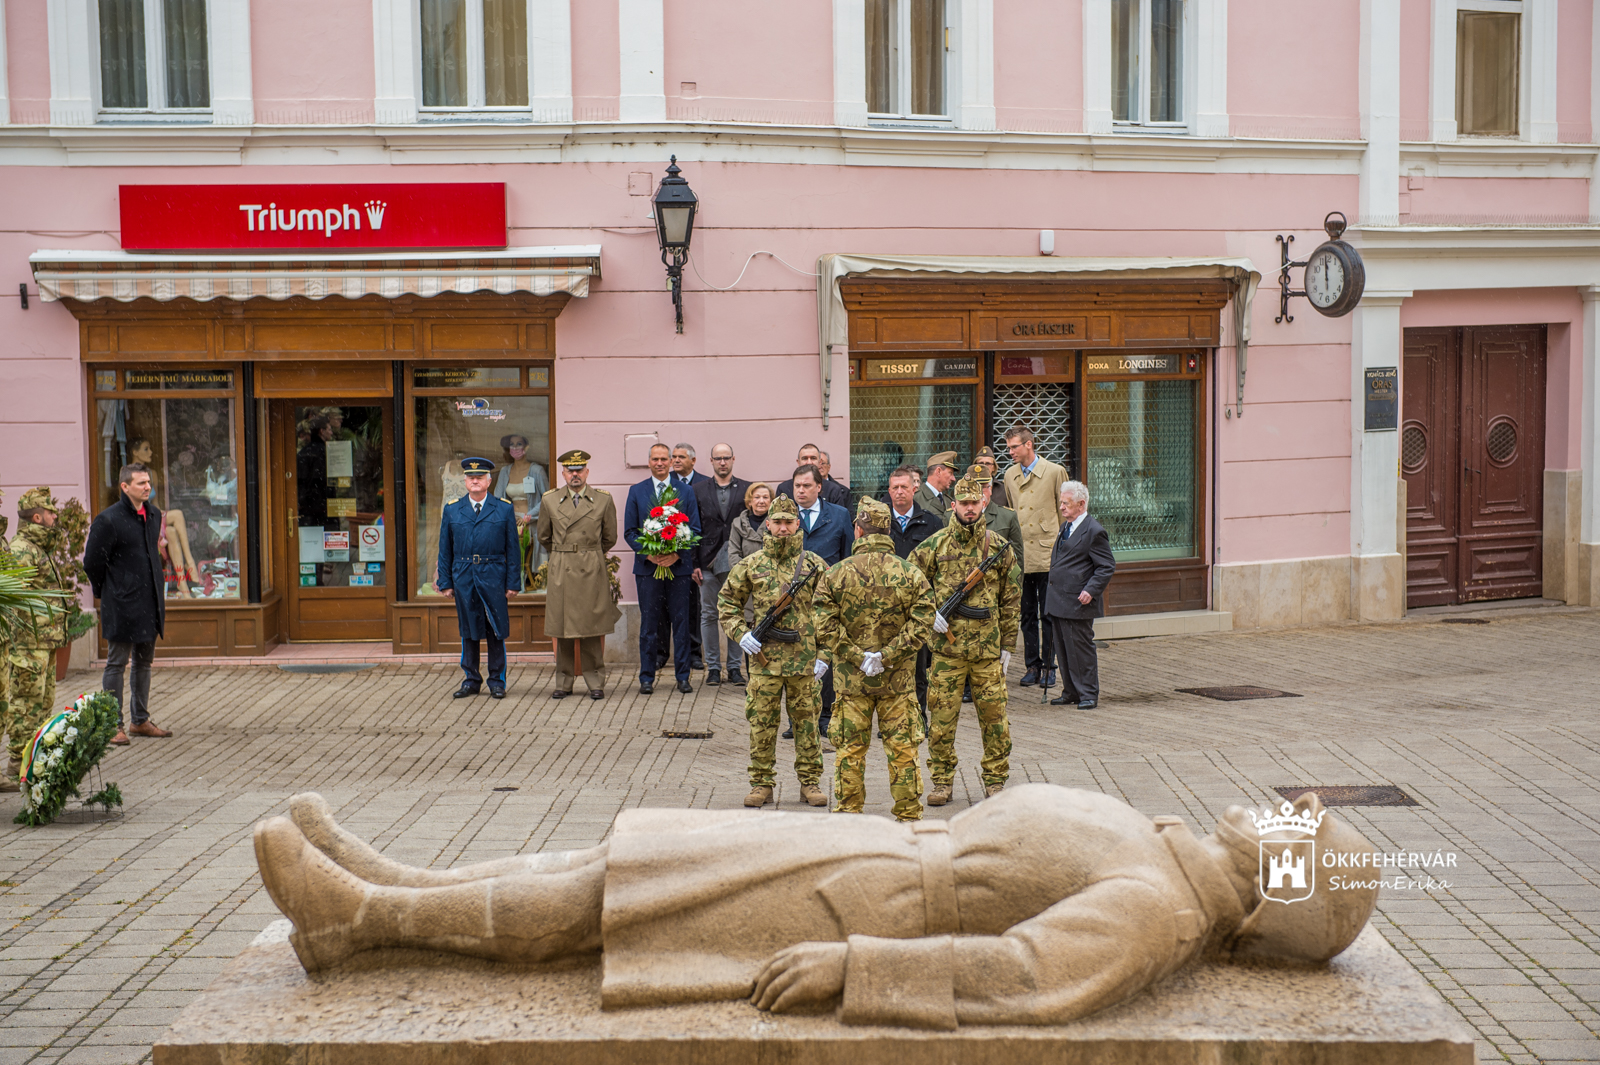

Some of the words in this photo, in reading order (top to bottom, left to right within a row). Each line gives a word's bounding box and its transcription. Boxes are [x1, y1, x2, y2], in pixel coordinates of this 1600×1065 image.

[239, 202, 361, 238] Triumph
[1013, 321, 1036, 336] ÓRA
[1038, 321, 1076, 335] ÉKSZER
[880, 364, 919, 374] TISSOT
[1118, 359, 1167, 370] LONGINES
[182, 374, 233, 382] MÁRKABOLT
